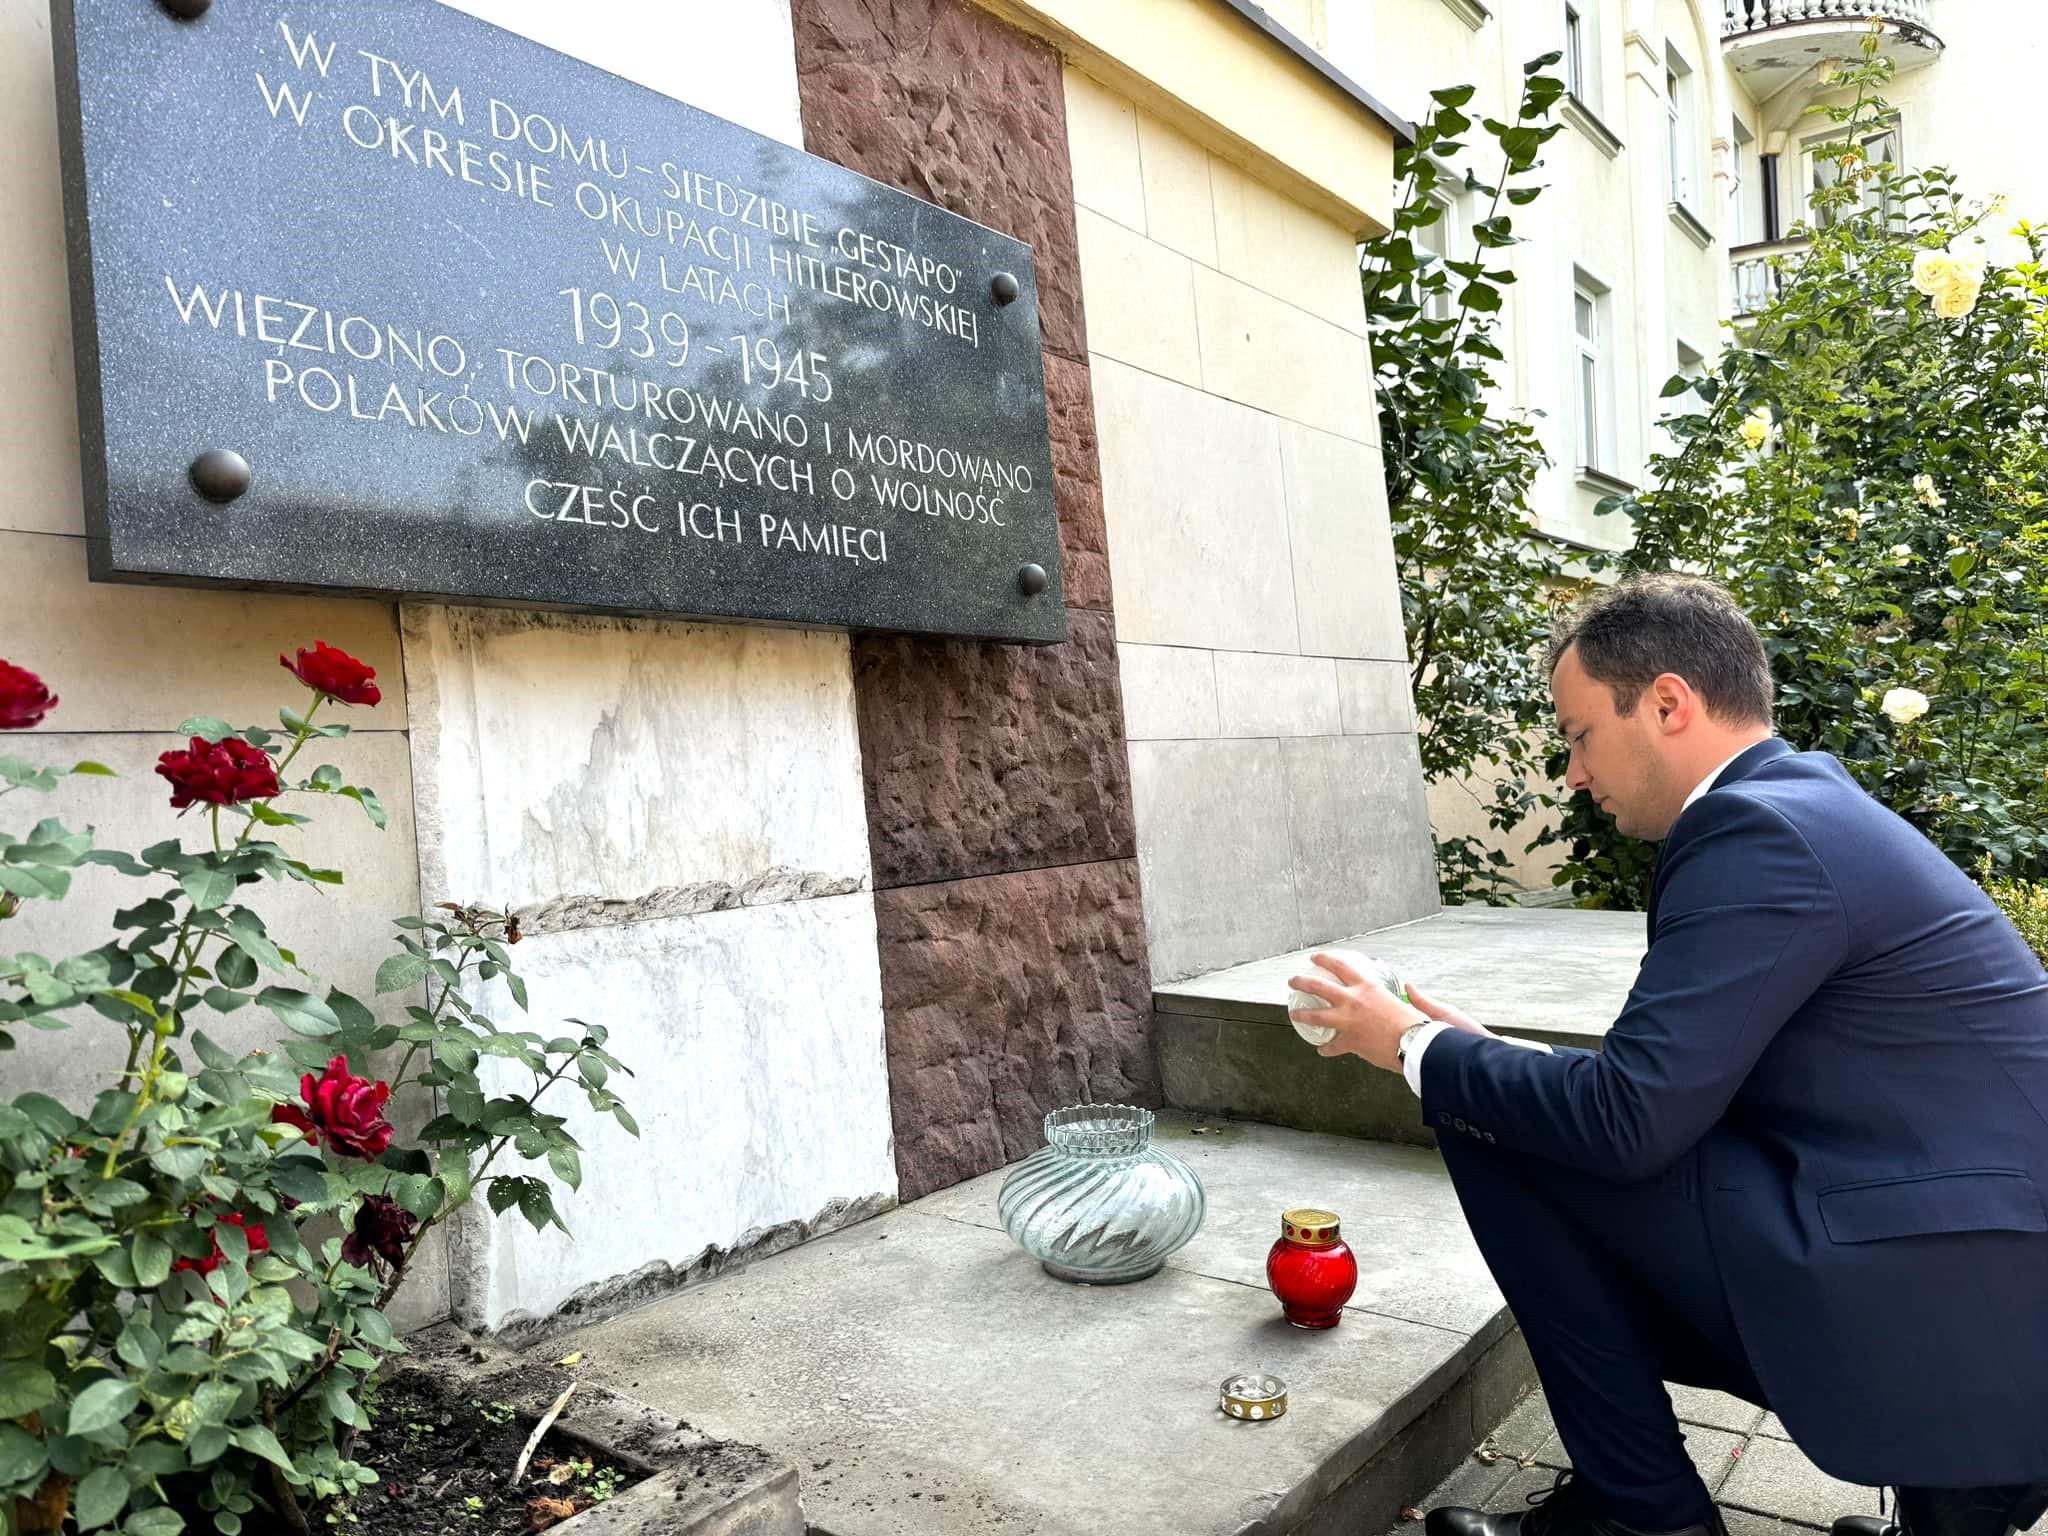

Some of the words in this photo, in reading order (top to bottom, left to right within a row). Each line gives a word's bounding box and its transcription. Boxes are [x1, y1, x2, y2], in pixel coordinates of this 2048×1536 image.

[279, 21, 336, 78] W
[358, 49, 465, 126] TYM
[490, 98, 627, 179] DOMU
[662, 161, 820, 249] SIEDZIBIE
[256, 72, 312, 128] W
[343, 105, 553, 207] OKRESIE
[769, 243, 979, 348] HITLEROWSKIEJ
[600, 238, 640, 281] W
[660, 255, 790, 325] LATACH
[558, 287, 690, 368] 1939
[730, 335, 833, 402] 1945
[264, 358, 534, 446] POLAKÓW
[555, 413, 814, 496] WALCZĄCYCH
[831, 468, 856, 501] O
[870, 474, 1006, 527] WOLNOŚĆ
[496, 348, 809, 448] TORTUROWANO
[823, 421, 833, 455] I
[848, 427, 1033, 494] MORDOWANO
[524, 478, 660, 533] CZEŚĆ
[678, 501, 742, 544] ICH
[760, 513, 888, 567] PAMIĘCI
